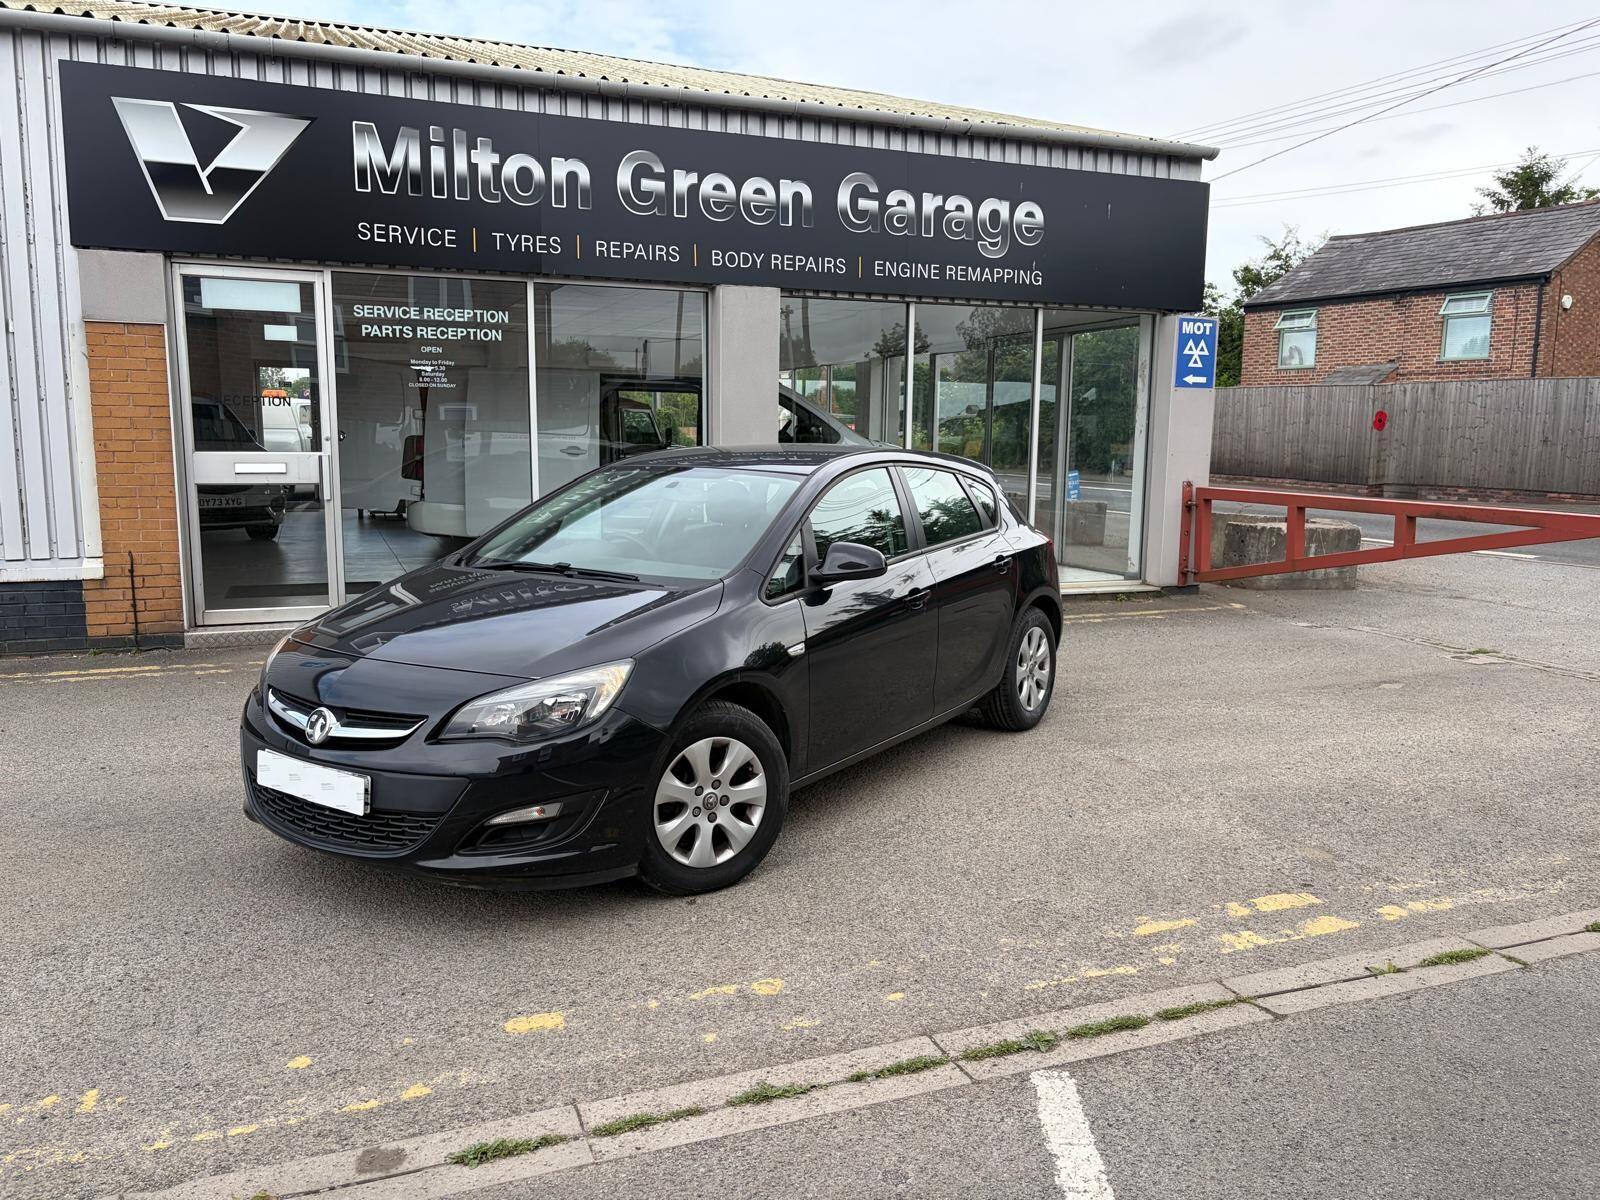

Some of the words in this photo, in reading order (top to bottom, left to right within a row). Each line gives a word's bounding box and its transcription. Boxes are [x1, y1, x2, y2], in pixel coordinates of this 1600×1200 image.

[352, 120, 592, 210] Milton
[616, 149, 814, 228] Green
[836, 171, 1046, 258] Garage
[357, 221, 458, 249] SERVICE
[492, 231, 562, 255] TYRES
[595, 239, 681, 263] REPAIRS
[711, 249, 766, 271] BODY
[771, 253, 847, 275] REPAIRS
[873, 260, 940, 281] ENGINE
[946, 265, 1044, 286] REMAPPING
[353, 304, 420, 320] SERVICE
[423, 307, 509, 324] RECEPTION
[361, 324, 413, 339] PARTS
[416, 326, 503, 342] RECEPTION
[1181, 322, 1213, 335] MOT
[420, 346, 443, 354] OPEN
